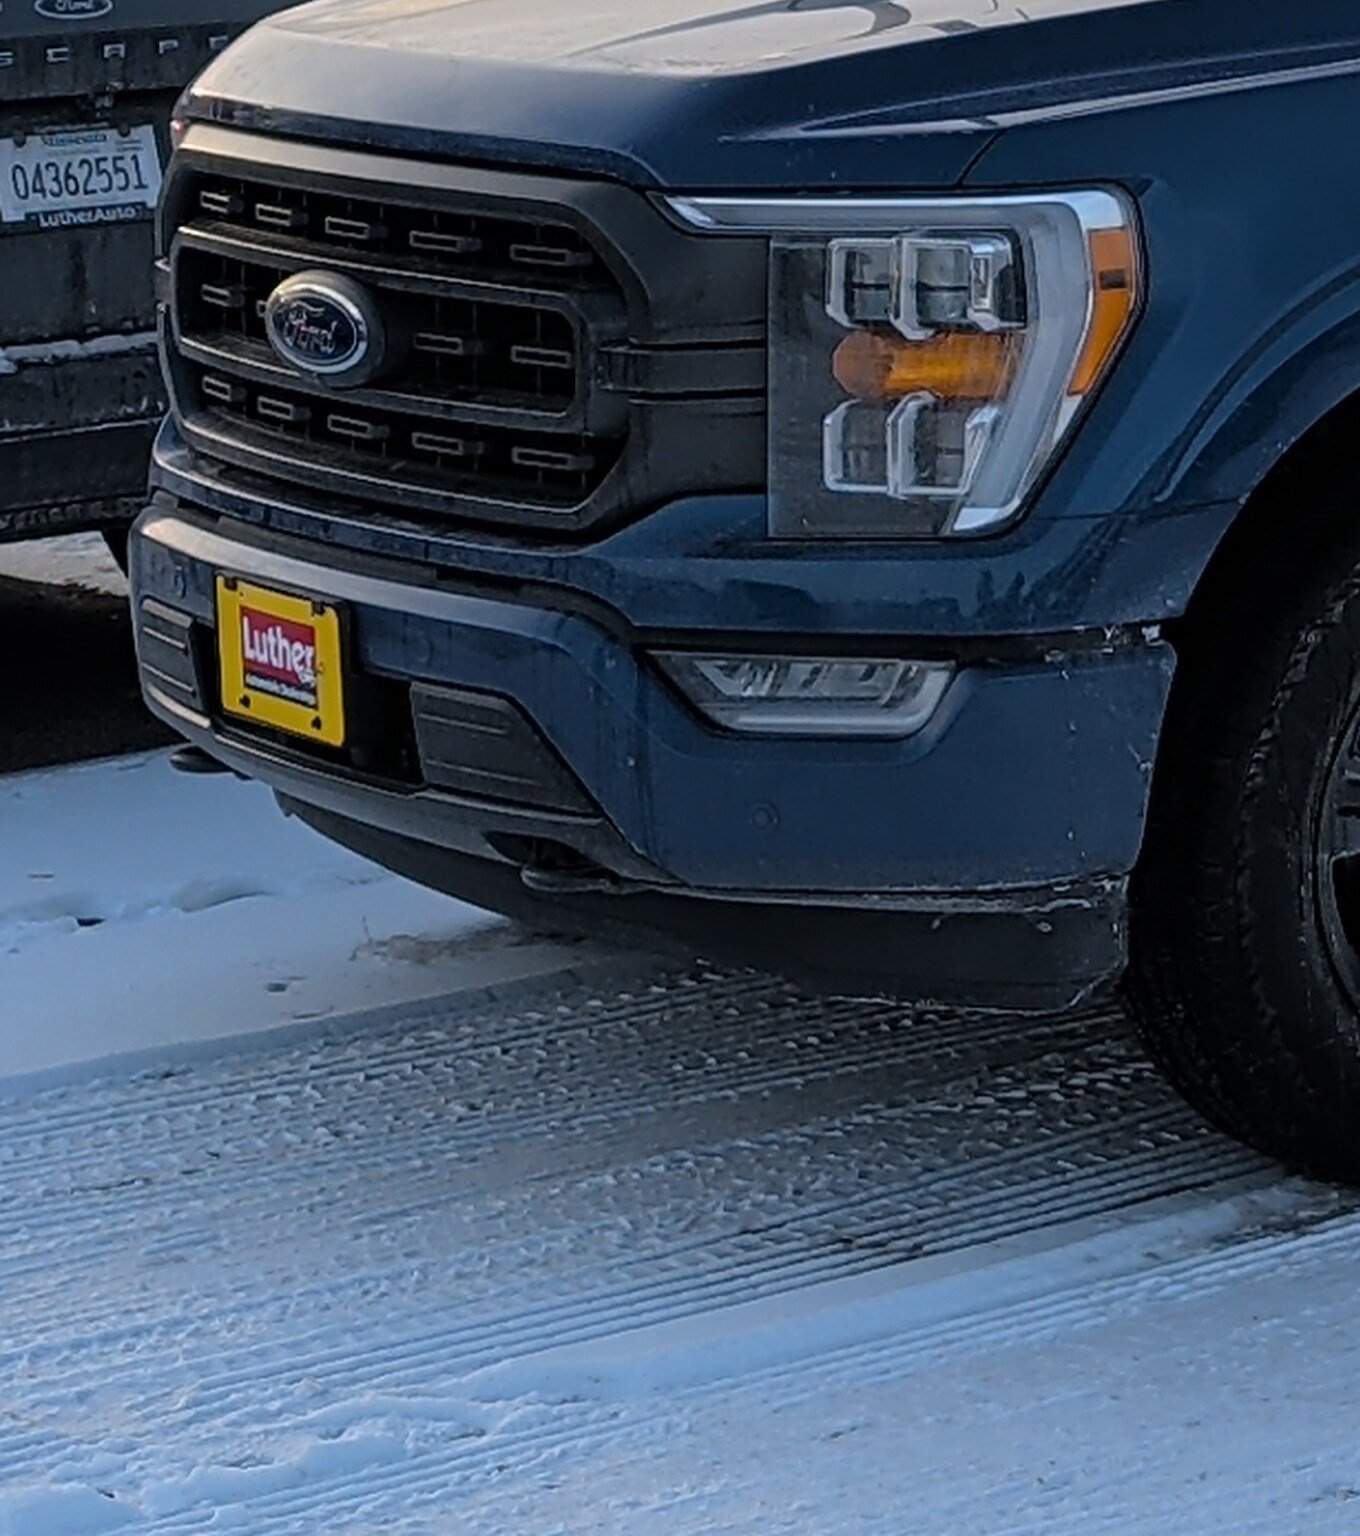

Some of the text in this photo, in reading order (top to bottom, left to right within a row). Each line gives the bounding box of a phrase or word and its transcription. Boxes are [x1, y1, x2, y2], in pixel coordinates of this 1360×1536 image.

[11, 154, 148, 200] 04362551
[282, 300, 339, 355] Ford
[243, 615, 315, 672] Luther
